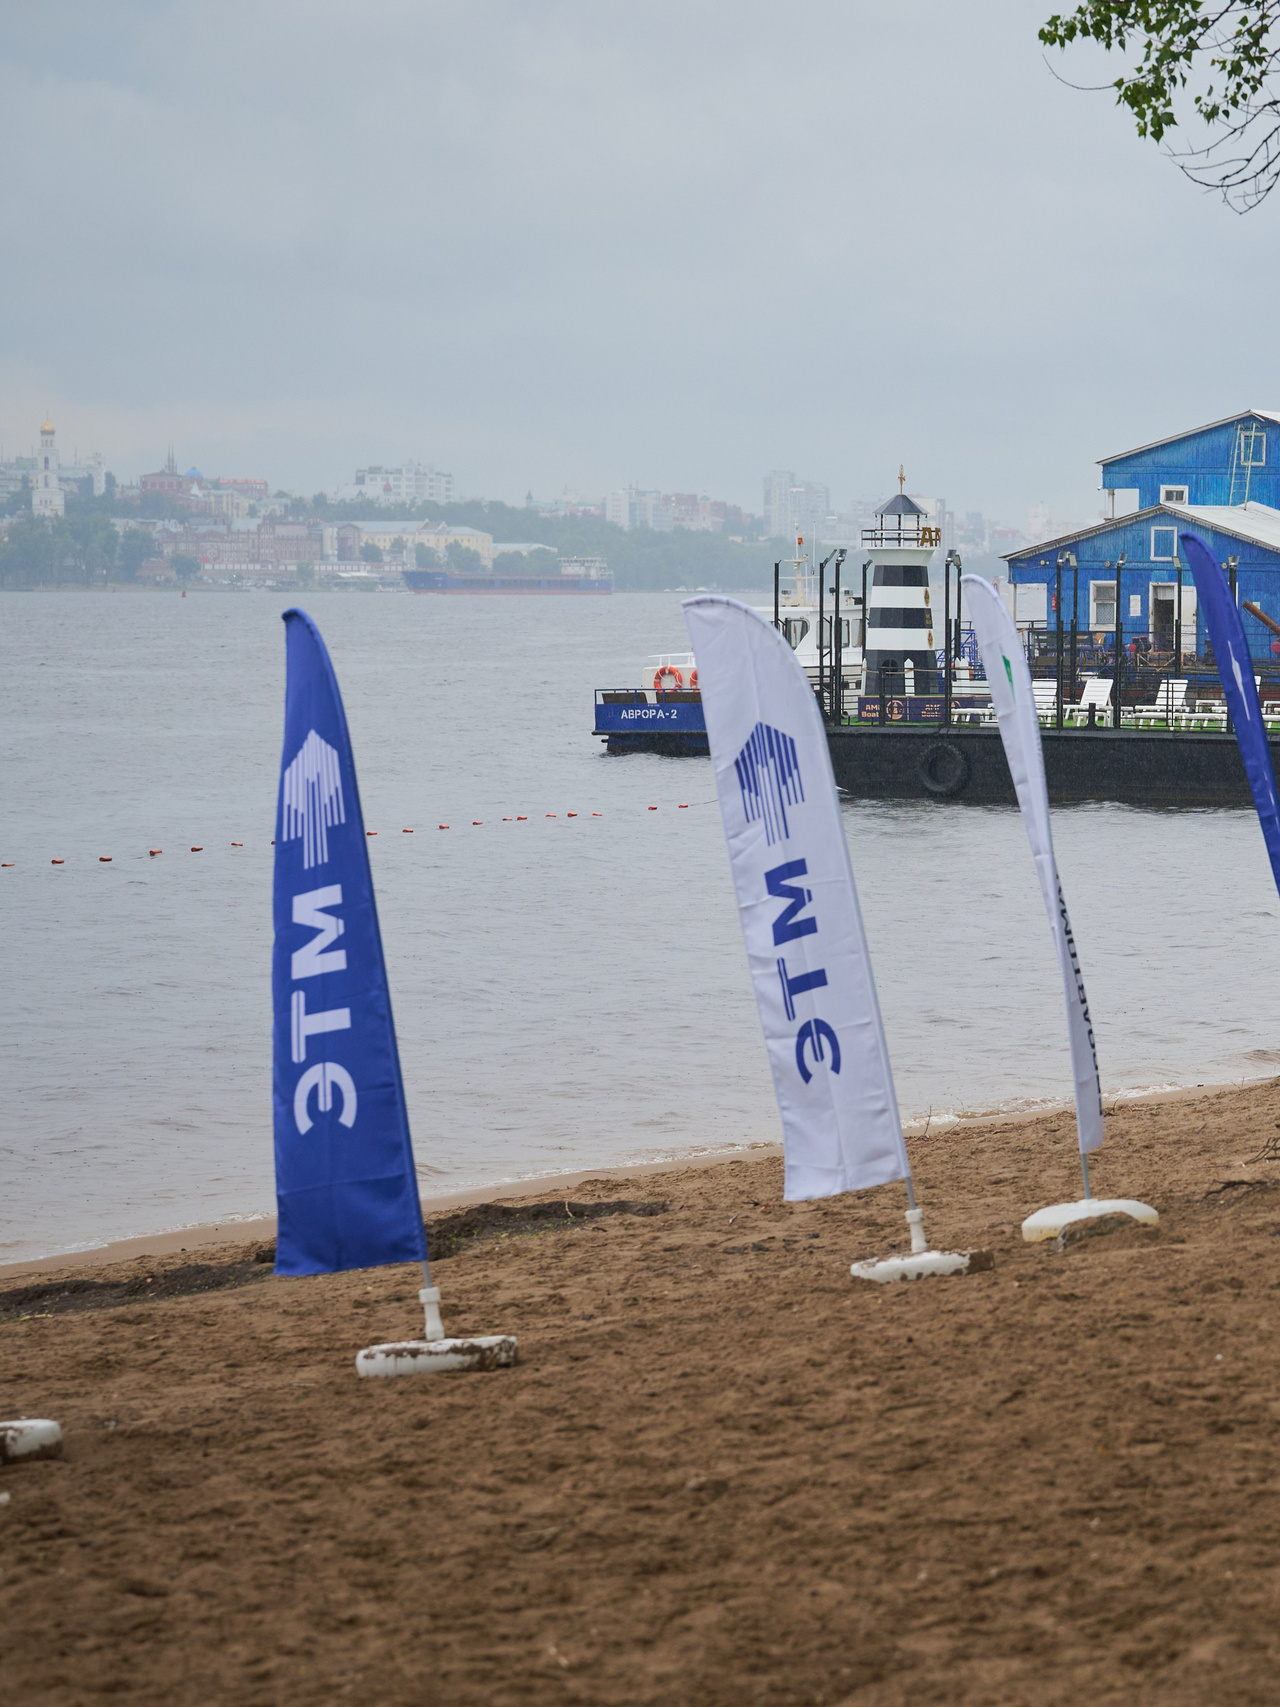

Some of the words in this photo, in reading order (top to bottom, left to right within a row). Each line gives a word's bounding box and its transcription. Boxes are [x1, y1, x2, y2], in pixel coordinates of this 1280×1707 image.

[621, 709, 678, 719] АВРОРА-2
[292, 884, 357, 1135] ЭТМ
[764, 857, 841, 1085] ЭТМ
